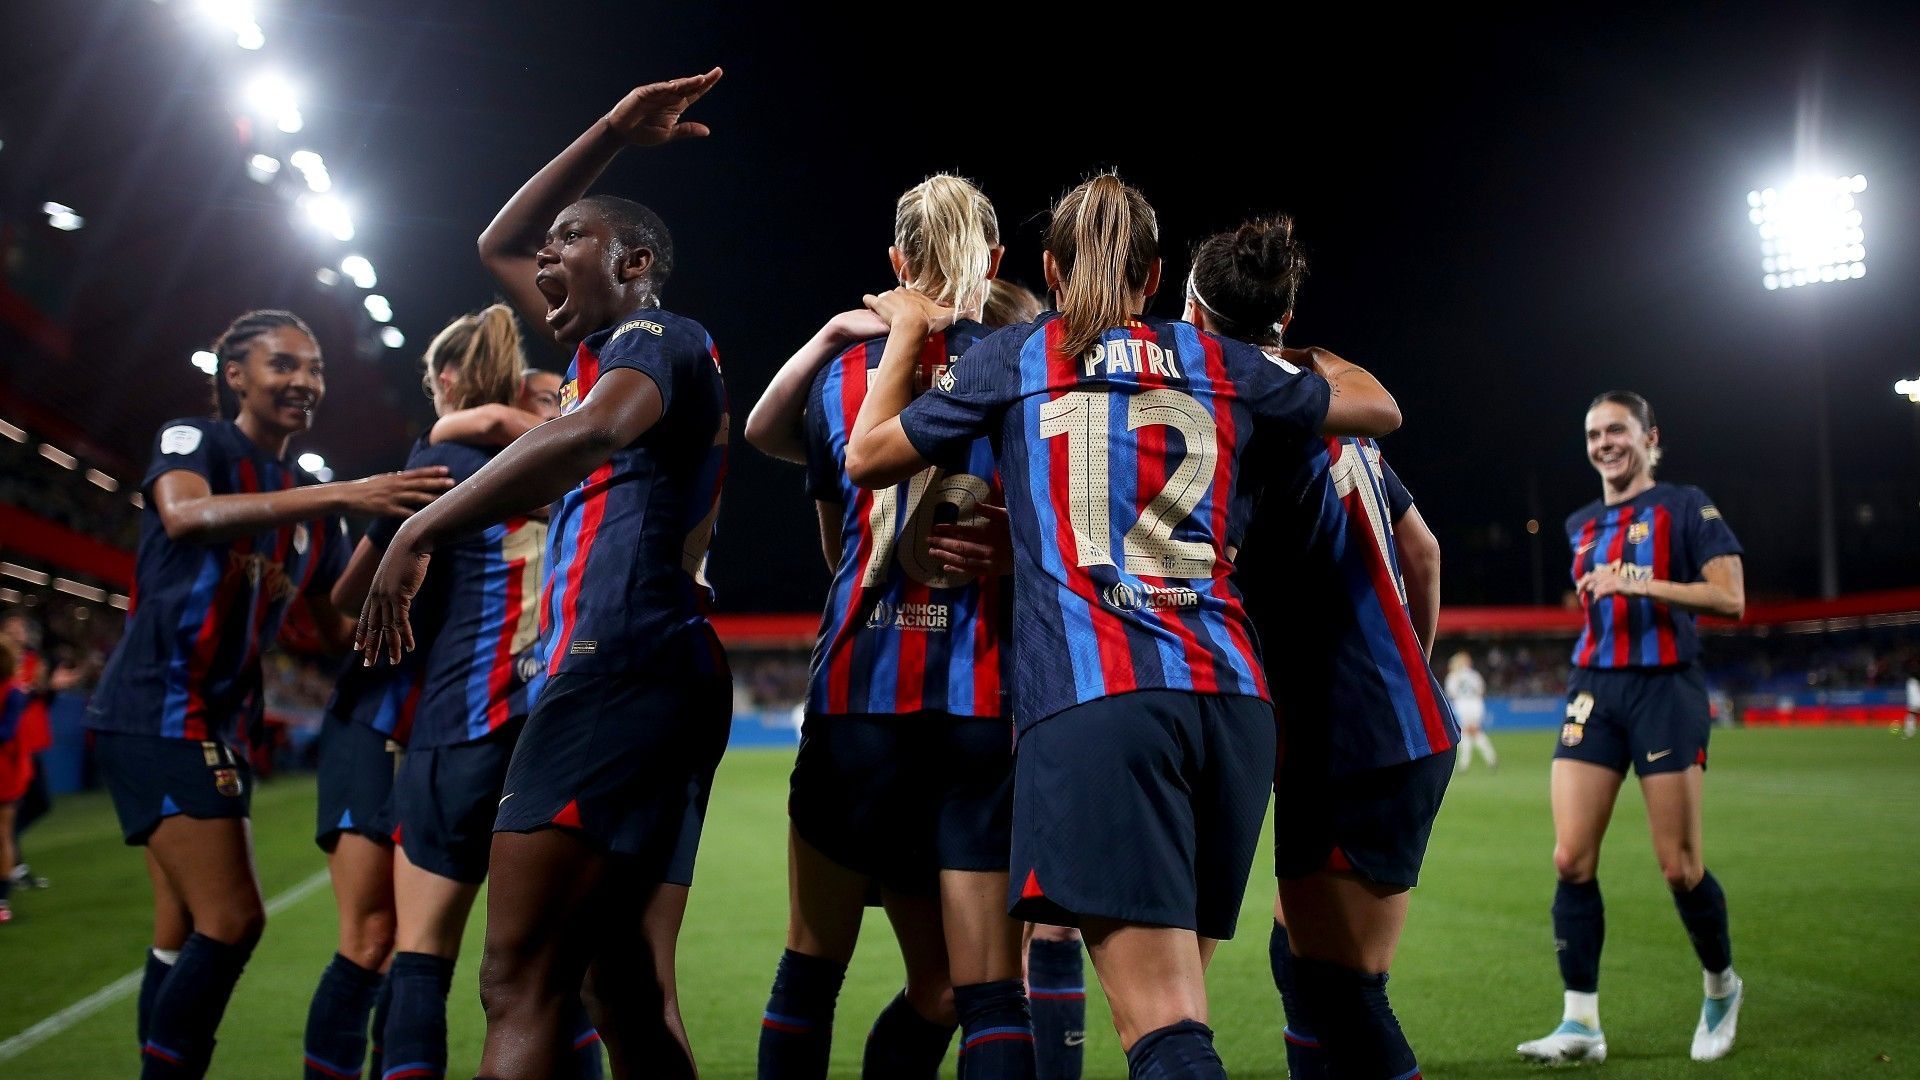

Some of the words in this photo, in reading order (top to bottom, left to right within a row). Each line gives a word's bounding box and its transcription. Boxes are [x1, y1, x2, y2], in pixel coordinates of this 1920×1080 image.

[1083, 338, 1181, 378] PATRI
[1039, 388, 1219, 579] 12
[860, 464, 991, 589] 16
[895, 603, 948, 616] UNHCR
[1145, 592, 1198, 607] ACNUR
[894, 614, 947, 627] ACNUR
